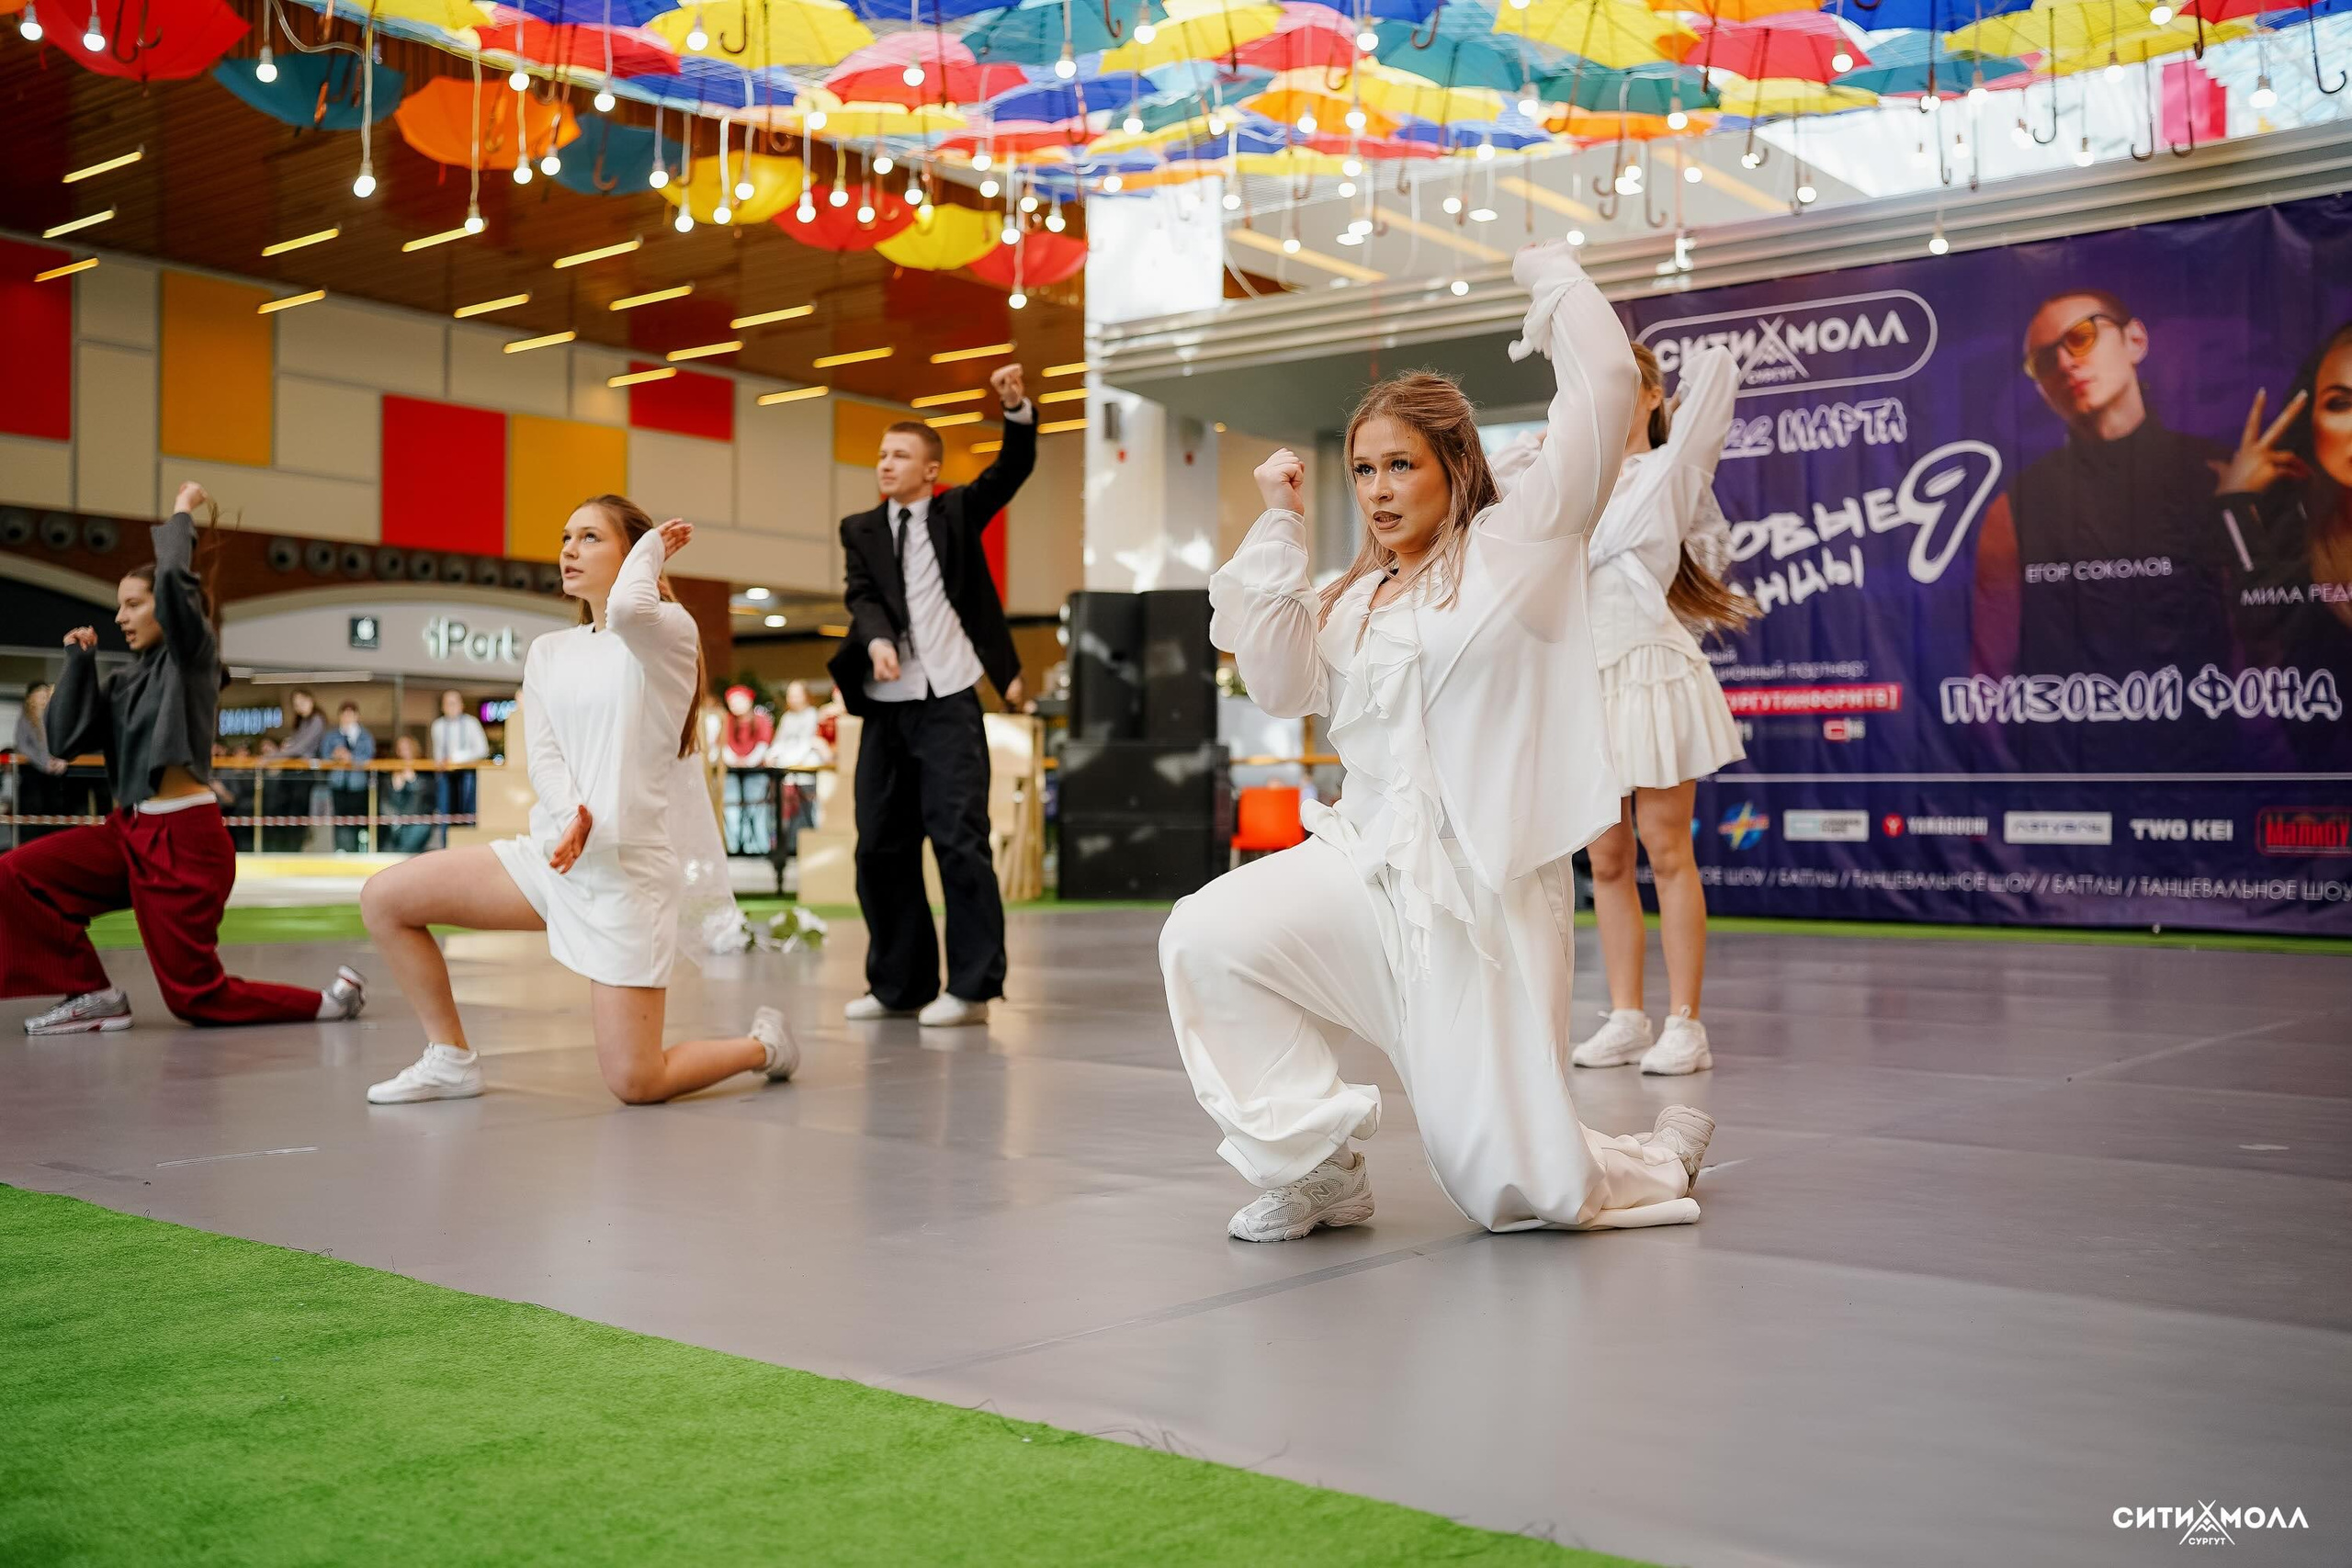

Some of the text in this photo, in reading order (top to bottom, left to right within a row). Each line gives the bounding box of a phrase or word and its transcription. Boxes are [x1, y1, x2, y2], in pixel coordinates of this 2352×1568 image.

[1777, 396, 1908, 454] МАРТА
[1727, 487, 1900, 562] ОВЫЕ
[1729, 544, 1865, 615] НЦЫ
[2025, 556, 2174, 584] ЕГОР СОКОЛОВ
[2240, 581, 2352, 607] МИЛА РЕД
[1939, 663, 2183, 725] ПРИЗОВОЙ
[2130, 818, 2234, 841] TWO KEI
[2140, 874, 2297, 901] ТАНЦЕВАЛЬНОЕ
